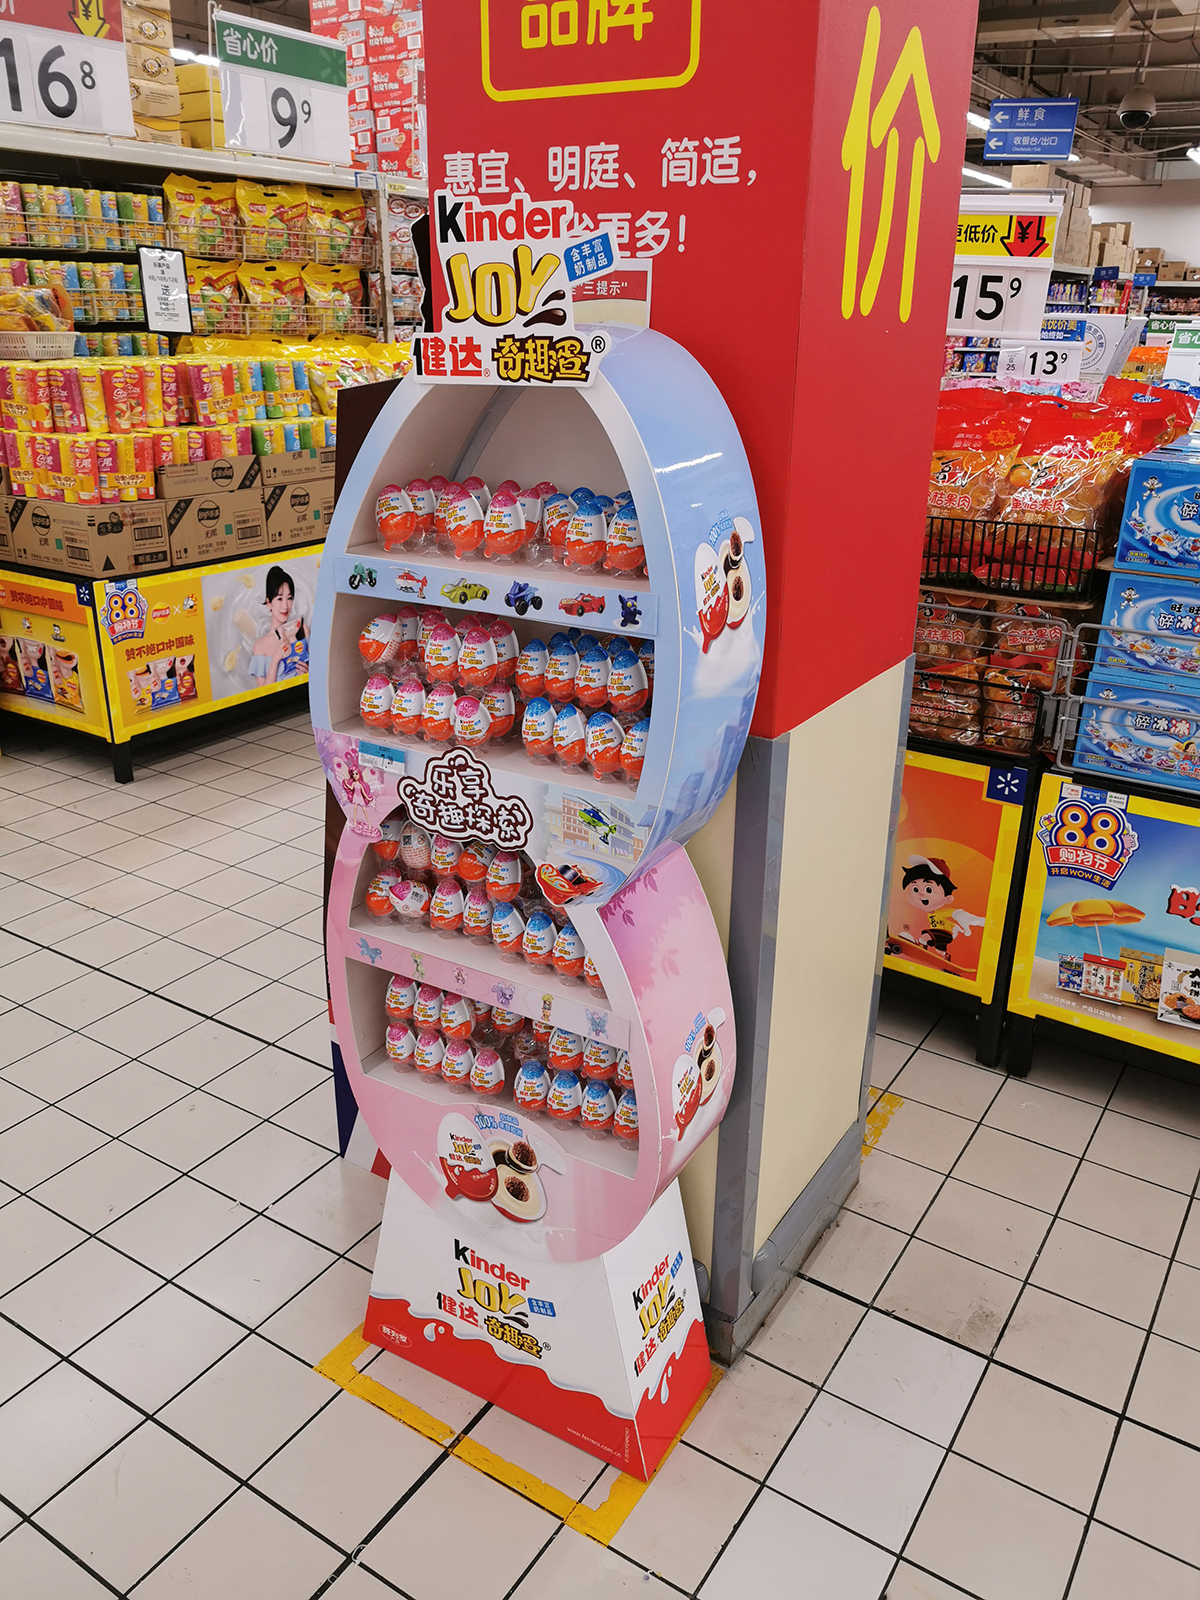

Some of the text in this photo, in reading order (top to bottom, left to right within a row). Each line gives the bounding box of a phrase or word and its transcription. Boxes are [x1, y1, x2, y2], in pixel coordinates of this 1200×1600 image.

[223, 27, 278, 65] 省心价
[1017, 107, 1046, 121] 鲜食
[1013, 136, 1058, 146] 收银台/出口
[437, 195, 567, 243] Kinder
[570, 238, 604, 263] 含丰富
[573, 252, 608, 277] 奶制品
[445, 244, 561, 327] JOY
[109, 592, 140, 624] 88
[125, 634, 195, 661] 赞不绝口中国味
[1135, 714, 1191, 738] 碎冰冰
[432, 767, 486, 801] 乐享
[412, 791, 525, 840] 奇趣探索
[1056, 805, 1119, 857] 88
[1059, 848, 1110, 871] 购物节
[449, 1132, 473, 1143] Kinder
[474, 1114, 498, 1130] 100%
[454, 1238, 530, 1291] Kinder
[457, 1266, 526, 1314] JOY
[632, 1253, 669, 1311] Kinder
[639, 1273, 671, 1341] JOY
